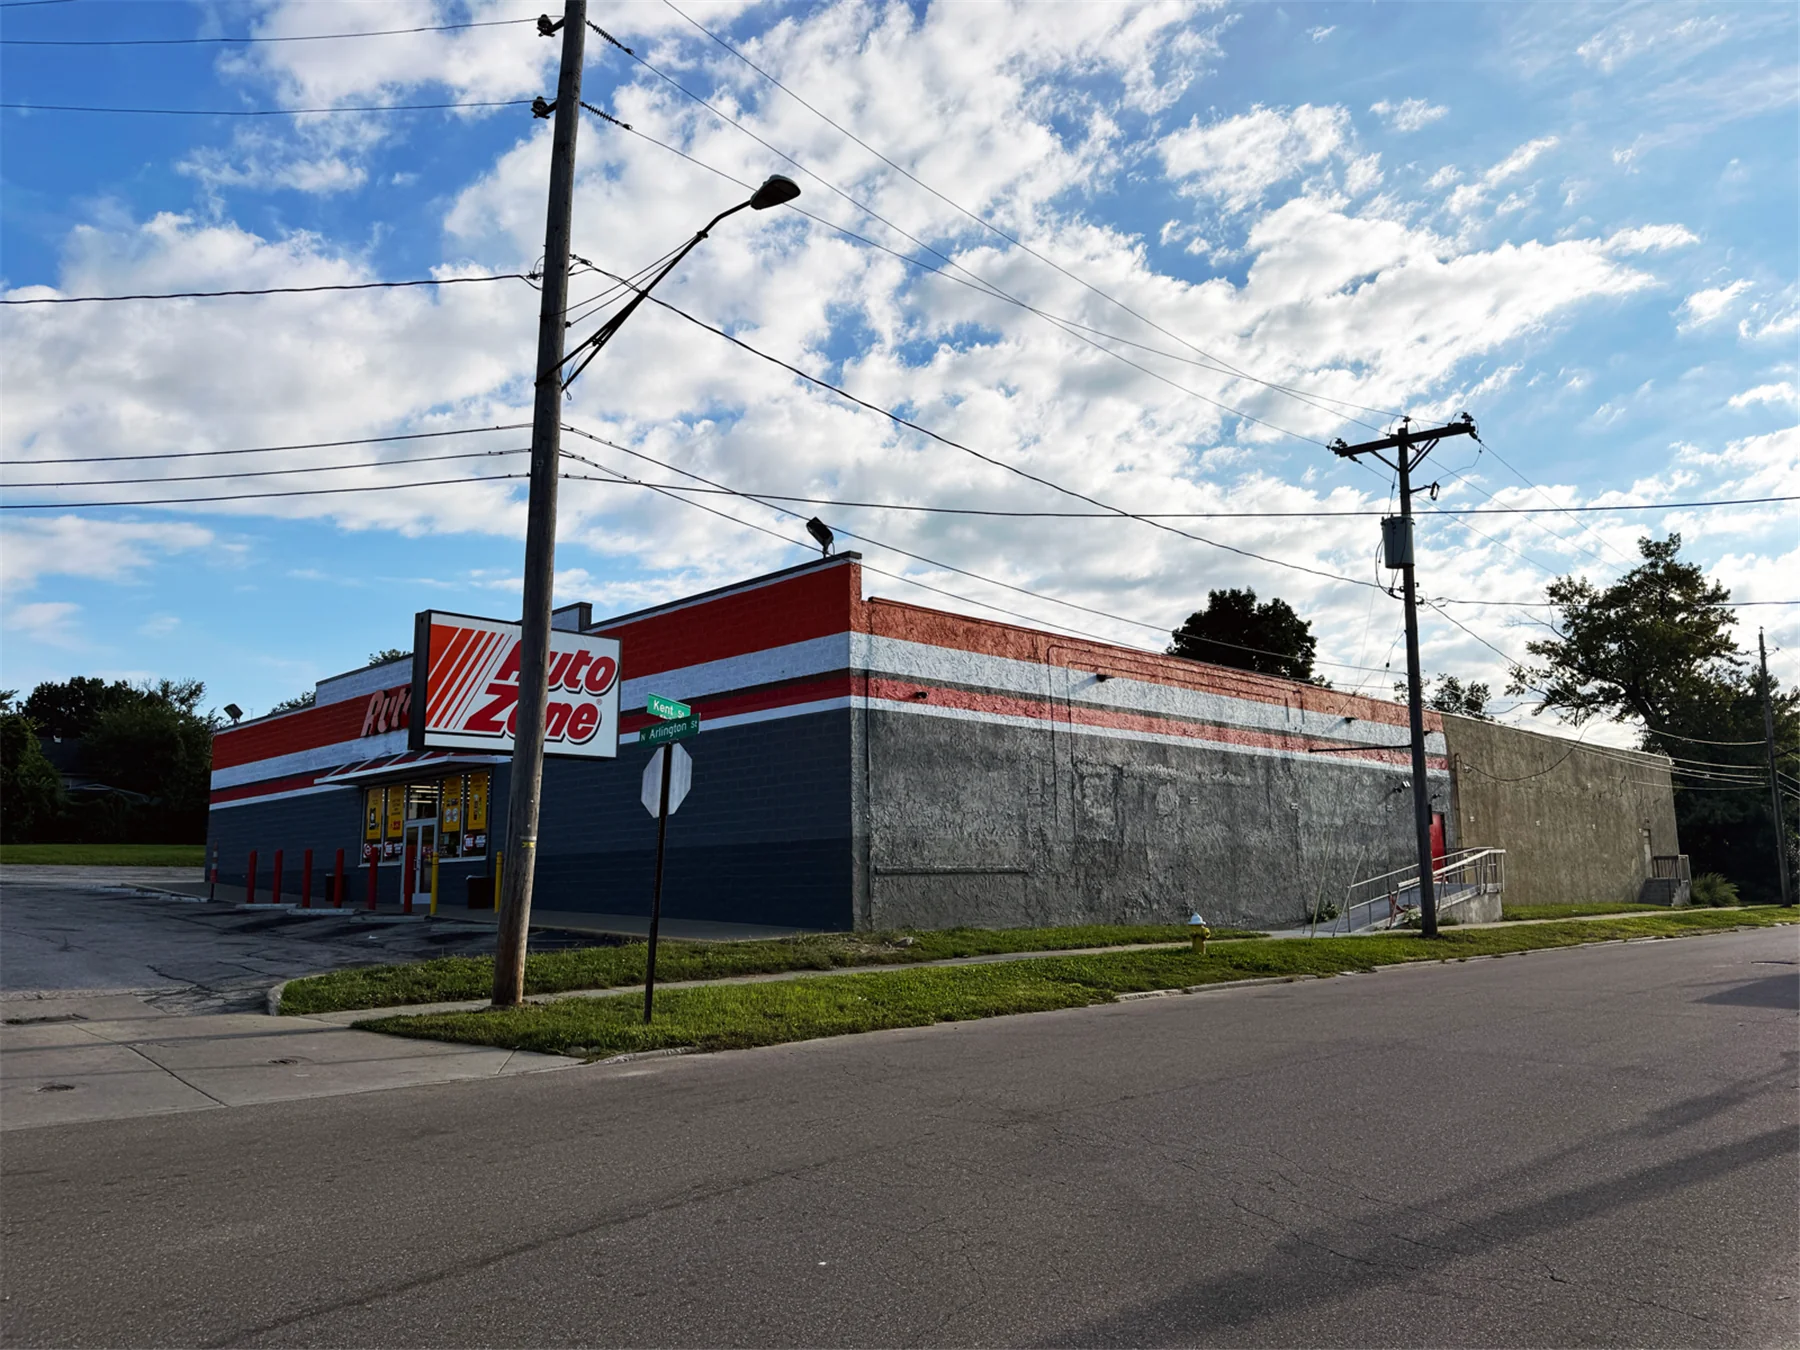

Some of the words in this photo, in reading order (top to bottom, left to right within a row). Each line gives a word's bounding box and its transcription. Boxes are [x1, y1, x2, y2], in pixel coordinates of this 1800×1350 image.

[653, 699, 674, 716] Kent
[640, 733, 646, 741] N
[649, 722, 687, 738] Arlington
[690, 720, 698, 729] St
